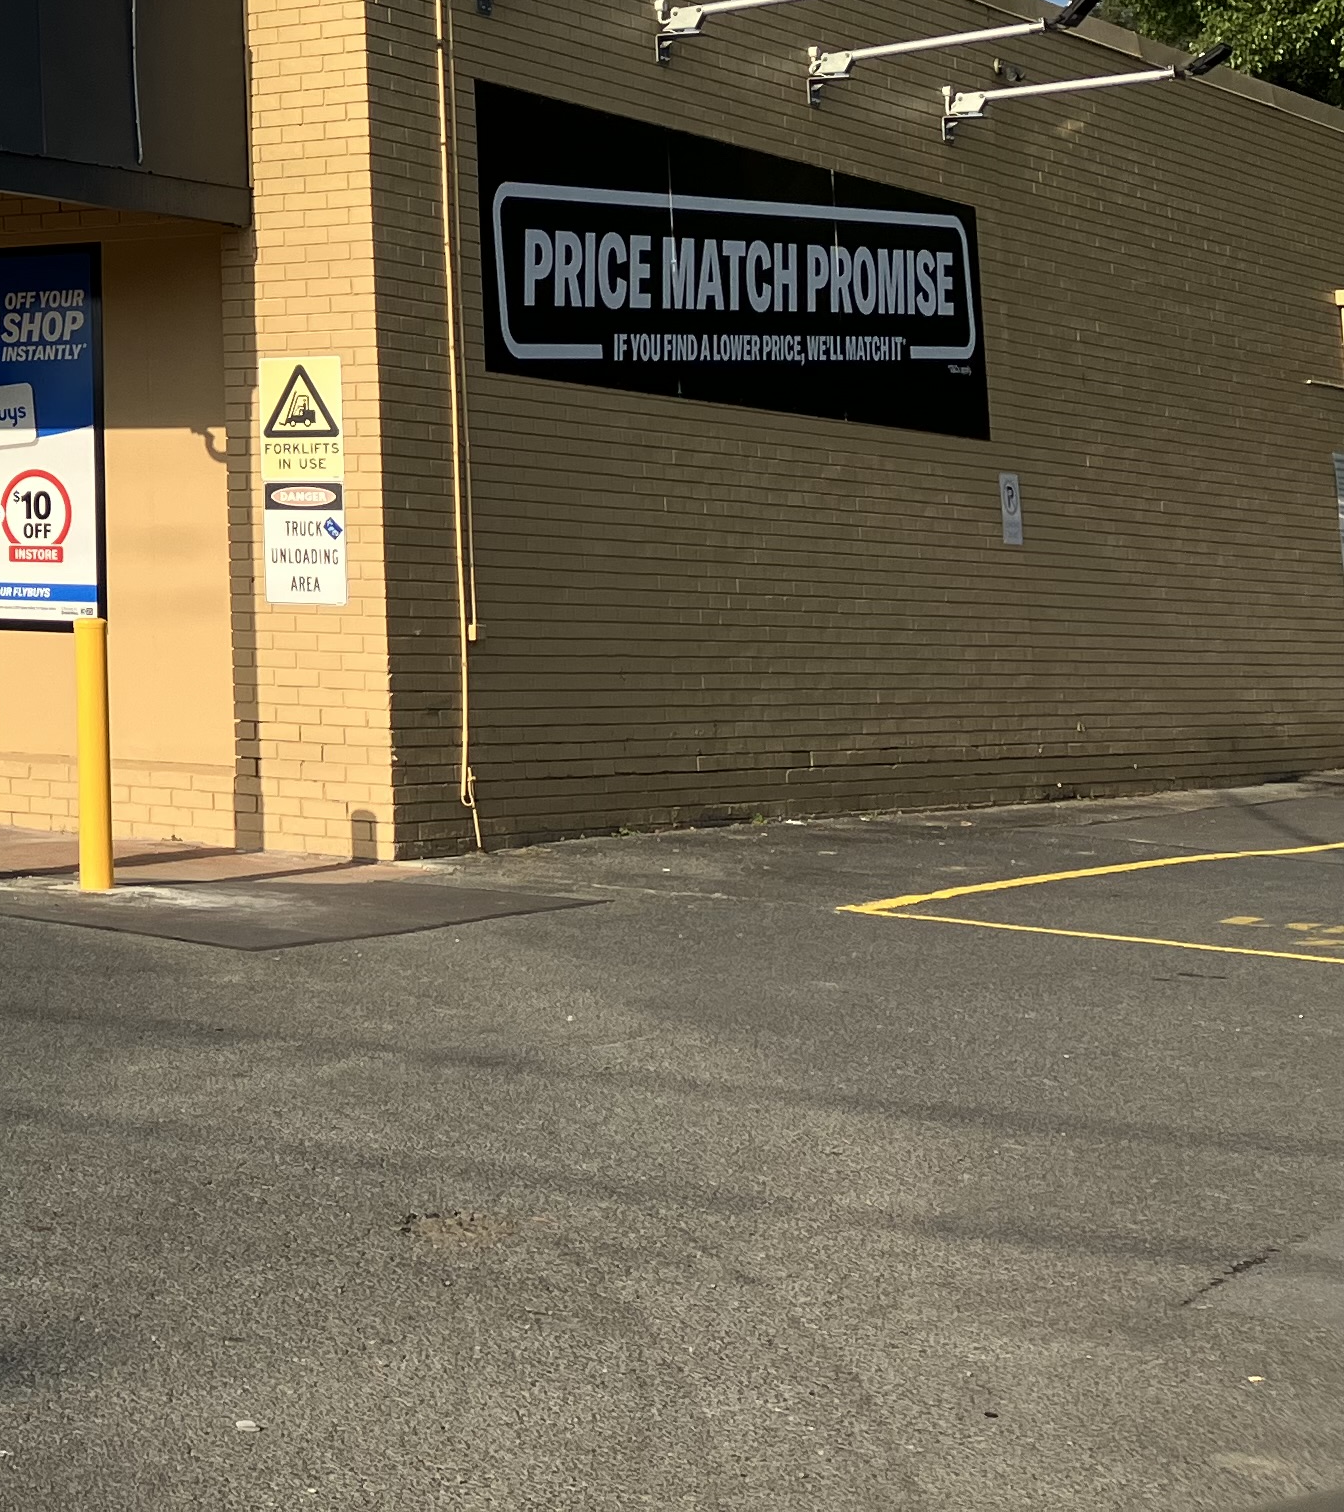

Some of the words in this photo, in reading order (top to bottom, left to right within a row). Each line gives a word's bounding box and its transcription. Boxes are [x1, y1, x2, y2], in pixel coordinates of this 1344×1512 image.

[524, 229, 652, 310] PRICE
[662, 237, 798, 314] MATCH
[807, 245, 955, 317] PROMISE
[4, 291, 36, 310] OFF
[38, 289, 85, 309] YOUR
[0, 310, 85, 344] SHOP
[613, 333, 628, 362] IF
[630, 333, 661, 362] YOU
[663, 334, 698, 362] FIND
[699, 334, 711, 361] A
[713, 334, 761, 362] LOWER
[762, 335, 806, 367] PRICE,
[806, 335, 844, 362] WE'LL
[845, 336, 889, 362] MATCH
[264, 443, 340, 455] FORKLIFTS
[278, 458, 291, 469] IN
[299, 458, 327, 470] USE
[13, 490, 52, 520] $10
[279, 491, 327, 502] DANGER
[23, 522, 52, 539] OFF
[284, 520, 323, 537] TRUCK
[14, 548, 59, 561] INSTORE
[271, 547, 340, 565] UNLOADING
[13, 586, 51, 598] FLYBUYS
[290, 576, 321, 592] AREA
